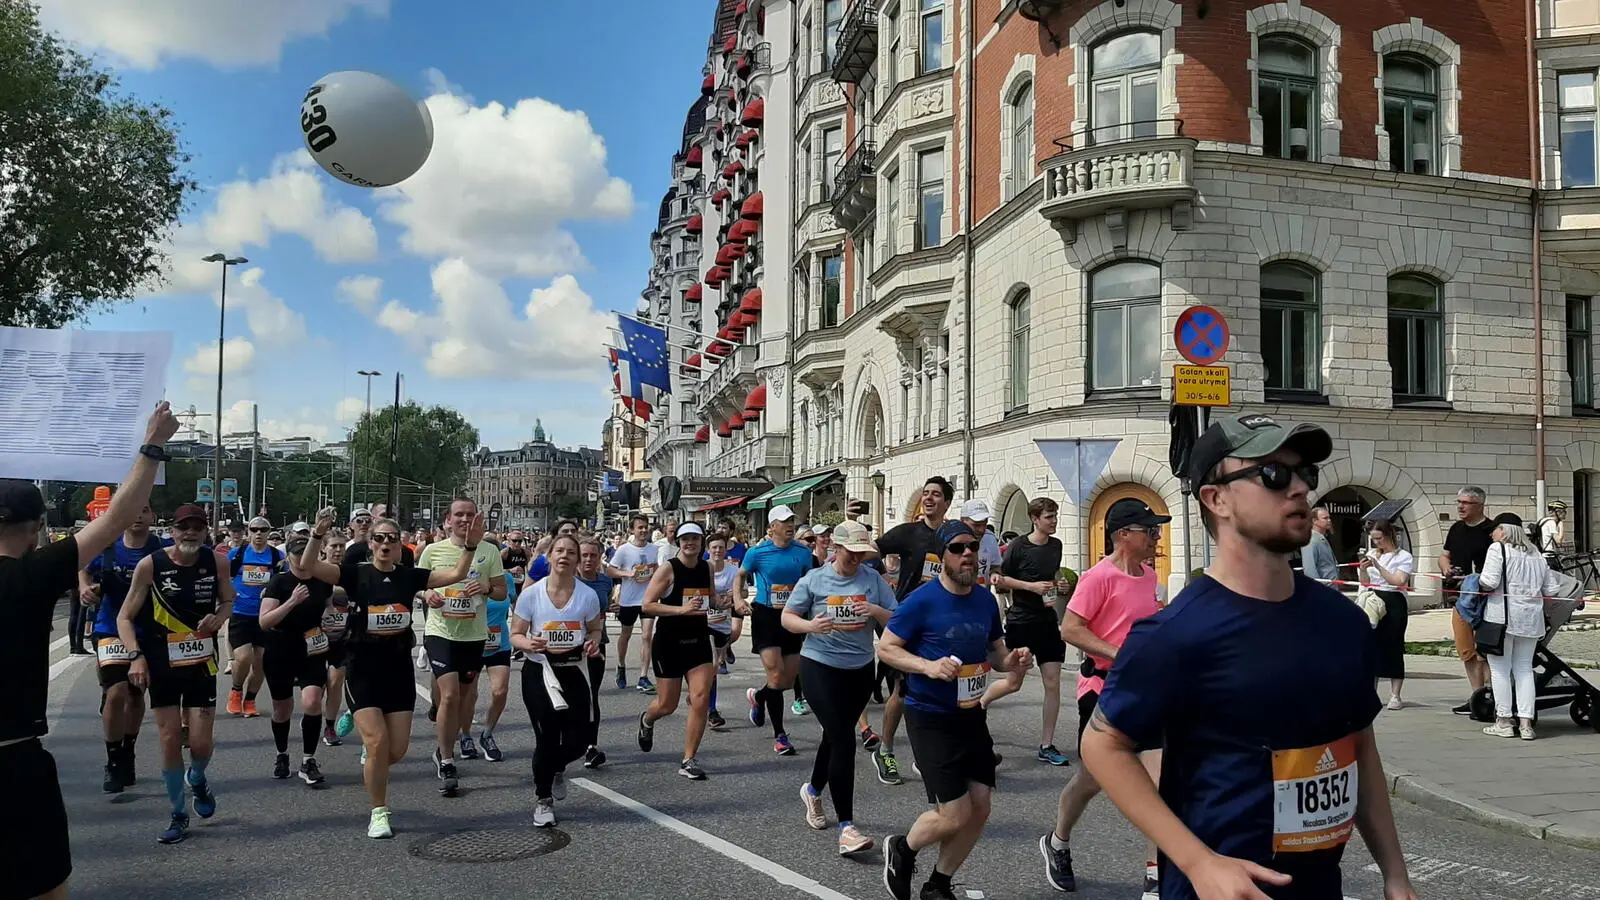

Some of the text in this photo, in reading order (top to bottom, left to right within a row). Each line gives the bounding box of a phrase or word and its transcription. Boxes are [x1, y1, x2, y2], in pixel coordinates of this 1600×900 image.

[1179, 367, 1225, 376] Gatan skall
[1199, 378, 1226, 387] utrymd
[1185, 392, 1221, 401] 30/5-6/6
[375, 613, 403, 626] 13652
[548, 630, 575, 643] 10605
[105, 644, 128, 654] 1602
[178, 640, 204, 653] 9346
[1295, 770, 1350, 815] 18352
